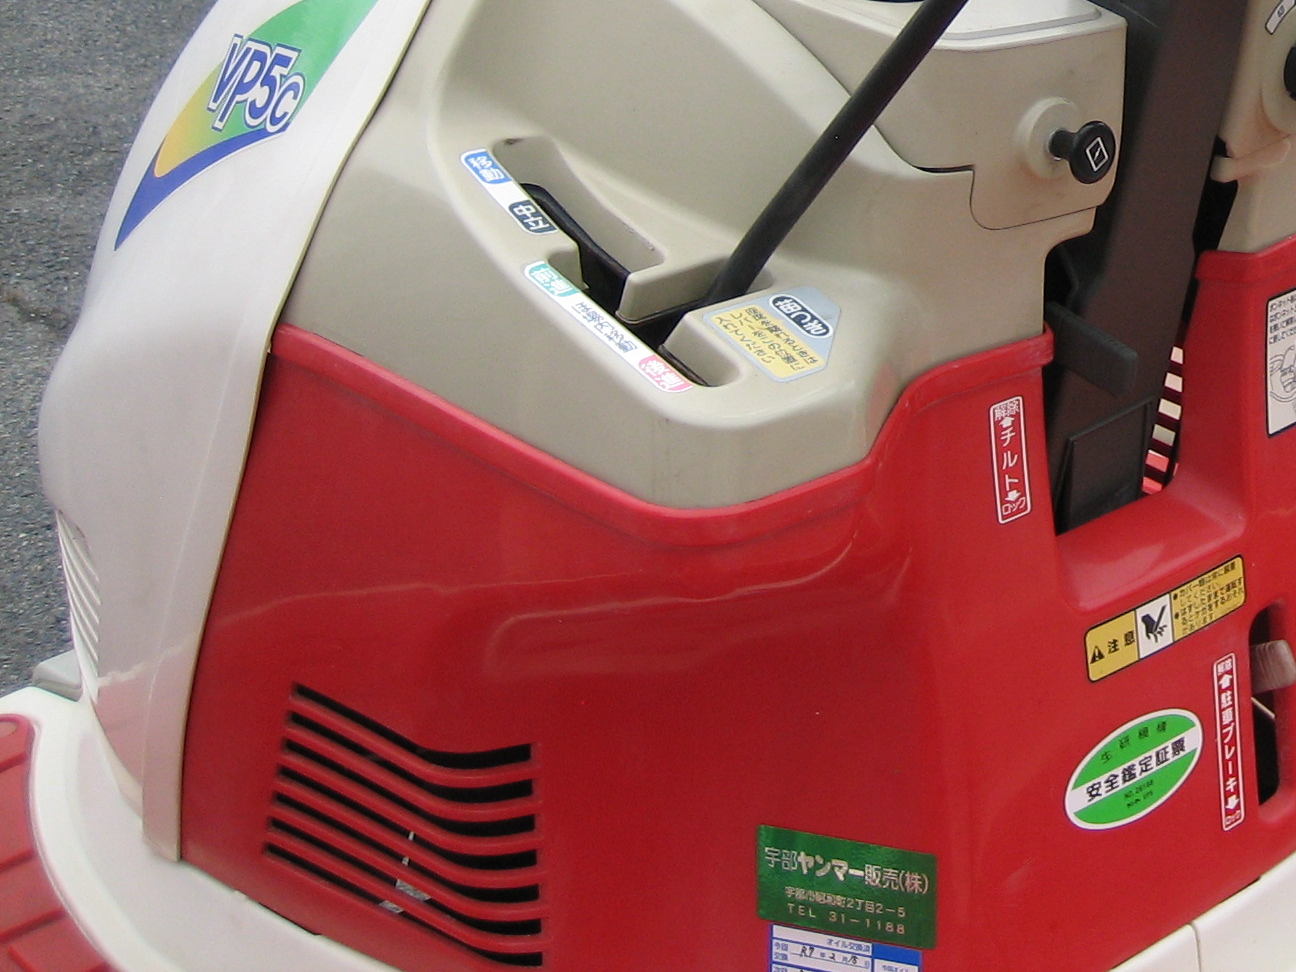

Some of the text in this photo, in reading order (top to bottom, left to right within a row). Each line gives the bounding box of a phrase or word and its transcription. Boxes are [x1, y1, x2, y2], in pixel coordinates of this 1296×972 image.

[511, 203, 550, 232] 中立
[1000, 426, 1019, 491] チルト
[1001, 496, 1026, 516] ロック
[1107, 630, 1136, 655] 注意
[1220, 689, 1239, 793] 駐車ブレーキ
[1086, 736, 1187, 803] 安全鑑定証票
[764, 846, 929, 895] 宇部ヤンマー販売(株)
[787, 903, 817, 919] TEL
